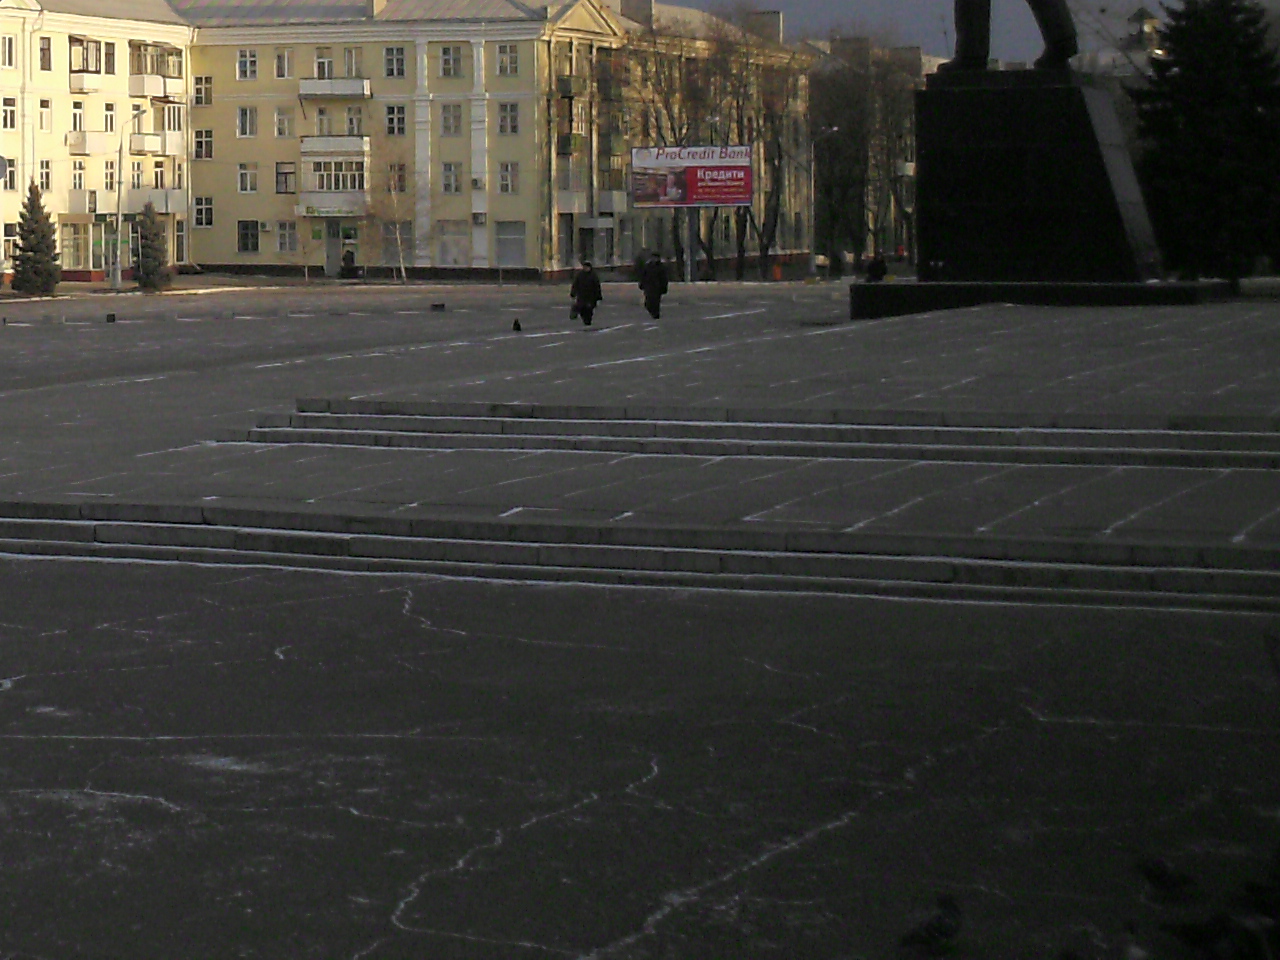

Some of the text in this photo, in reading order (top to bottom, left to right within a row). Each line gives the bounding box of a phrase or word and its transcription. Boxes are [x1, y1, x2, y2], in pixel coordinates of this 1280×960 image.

[656, 146, 751, 160] ProCredit Bank
[697, 169, 744, 179] Кредити
